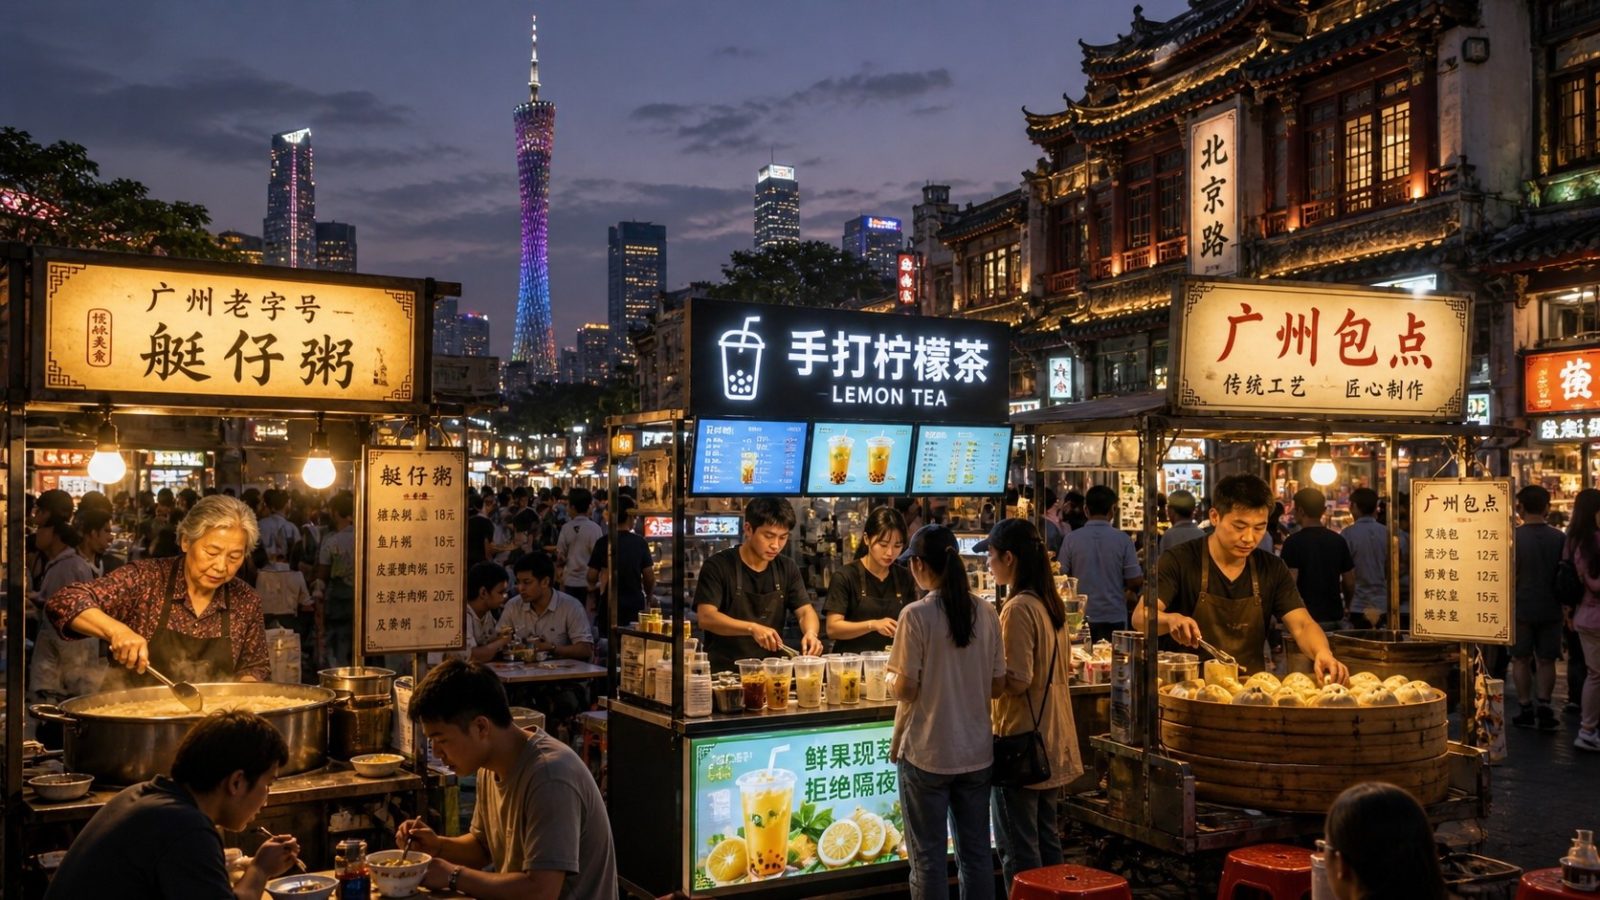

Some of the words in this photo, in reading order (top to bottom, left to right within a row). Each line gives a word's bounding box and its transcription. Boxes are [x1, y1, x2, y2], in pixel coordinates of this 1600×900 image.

[1200, 134, 1230, 258] 北京路
[146, 281, 321, 323] 广州老字号
[1216, 302, 1433, 369] 广州包点
[140, 322, 354, 390] 艇仔粥
[788, 329, 989, 383] 手打柠檬茶
[1223, 373, 1306, 398] 传统工艺
[1345, 378, 1424, 402] 匠心制作
[832, 385, 903, 405] LEMON
[911, 388, 948, 407] TEA
[379, 464, 453, 487] 艇仔粥
[1423, 493, 1499, 513] 广州包点
[434, 508, 455, 521] 18元
[434, 535, 456, 548] 18元
[1476, 529, 1500, 541] 12元
[1476, 550, 1500, 562] 12元
[434, 562, 456, 575] 15元
[1476, 571, 1500, 583] 12元
[433, 590, 455, 602] 20元
[1476, 592, 1500, 604] 15元
[433, 617, 455, 629] 15元
[1476, 612, 1500, 625] 15元
[805, 770, 897, 804] 拒绝隔夜
